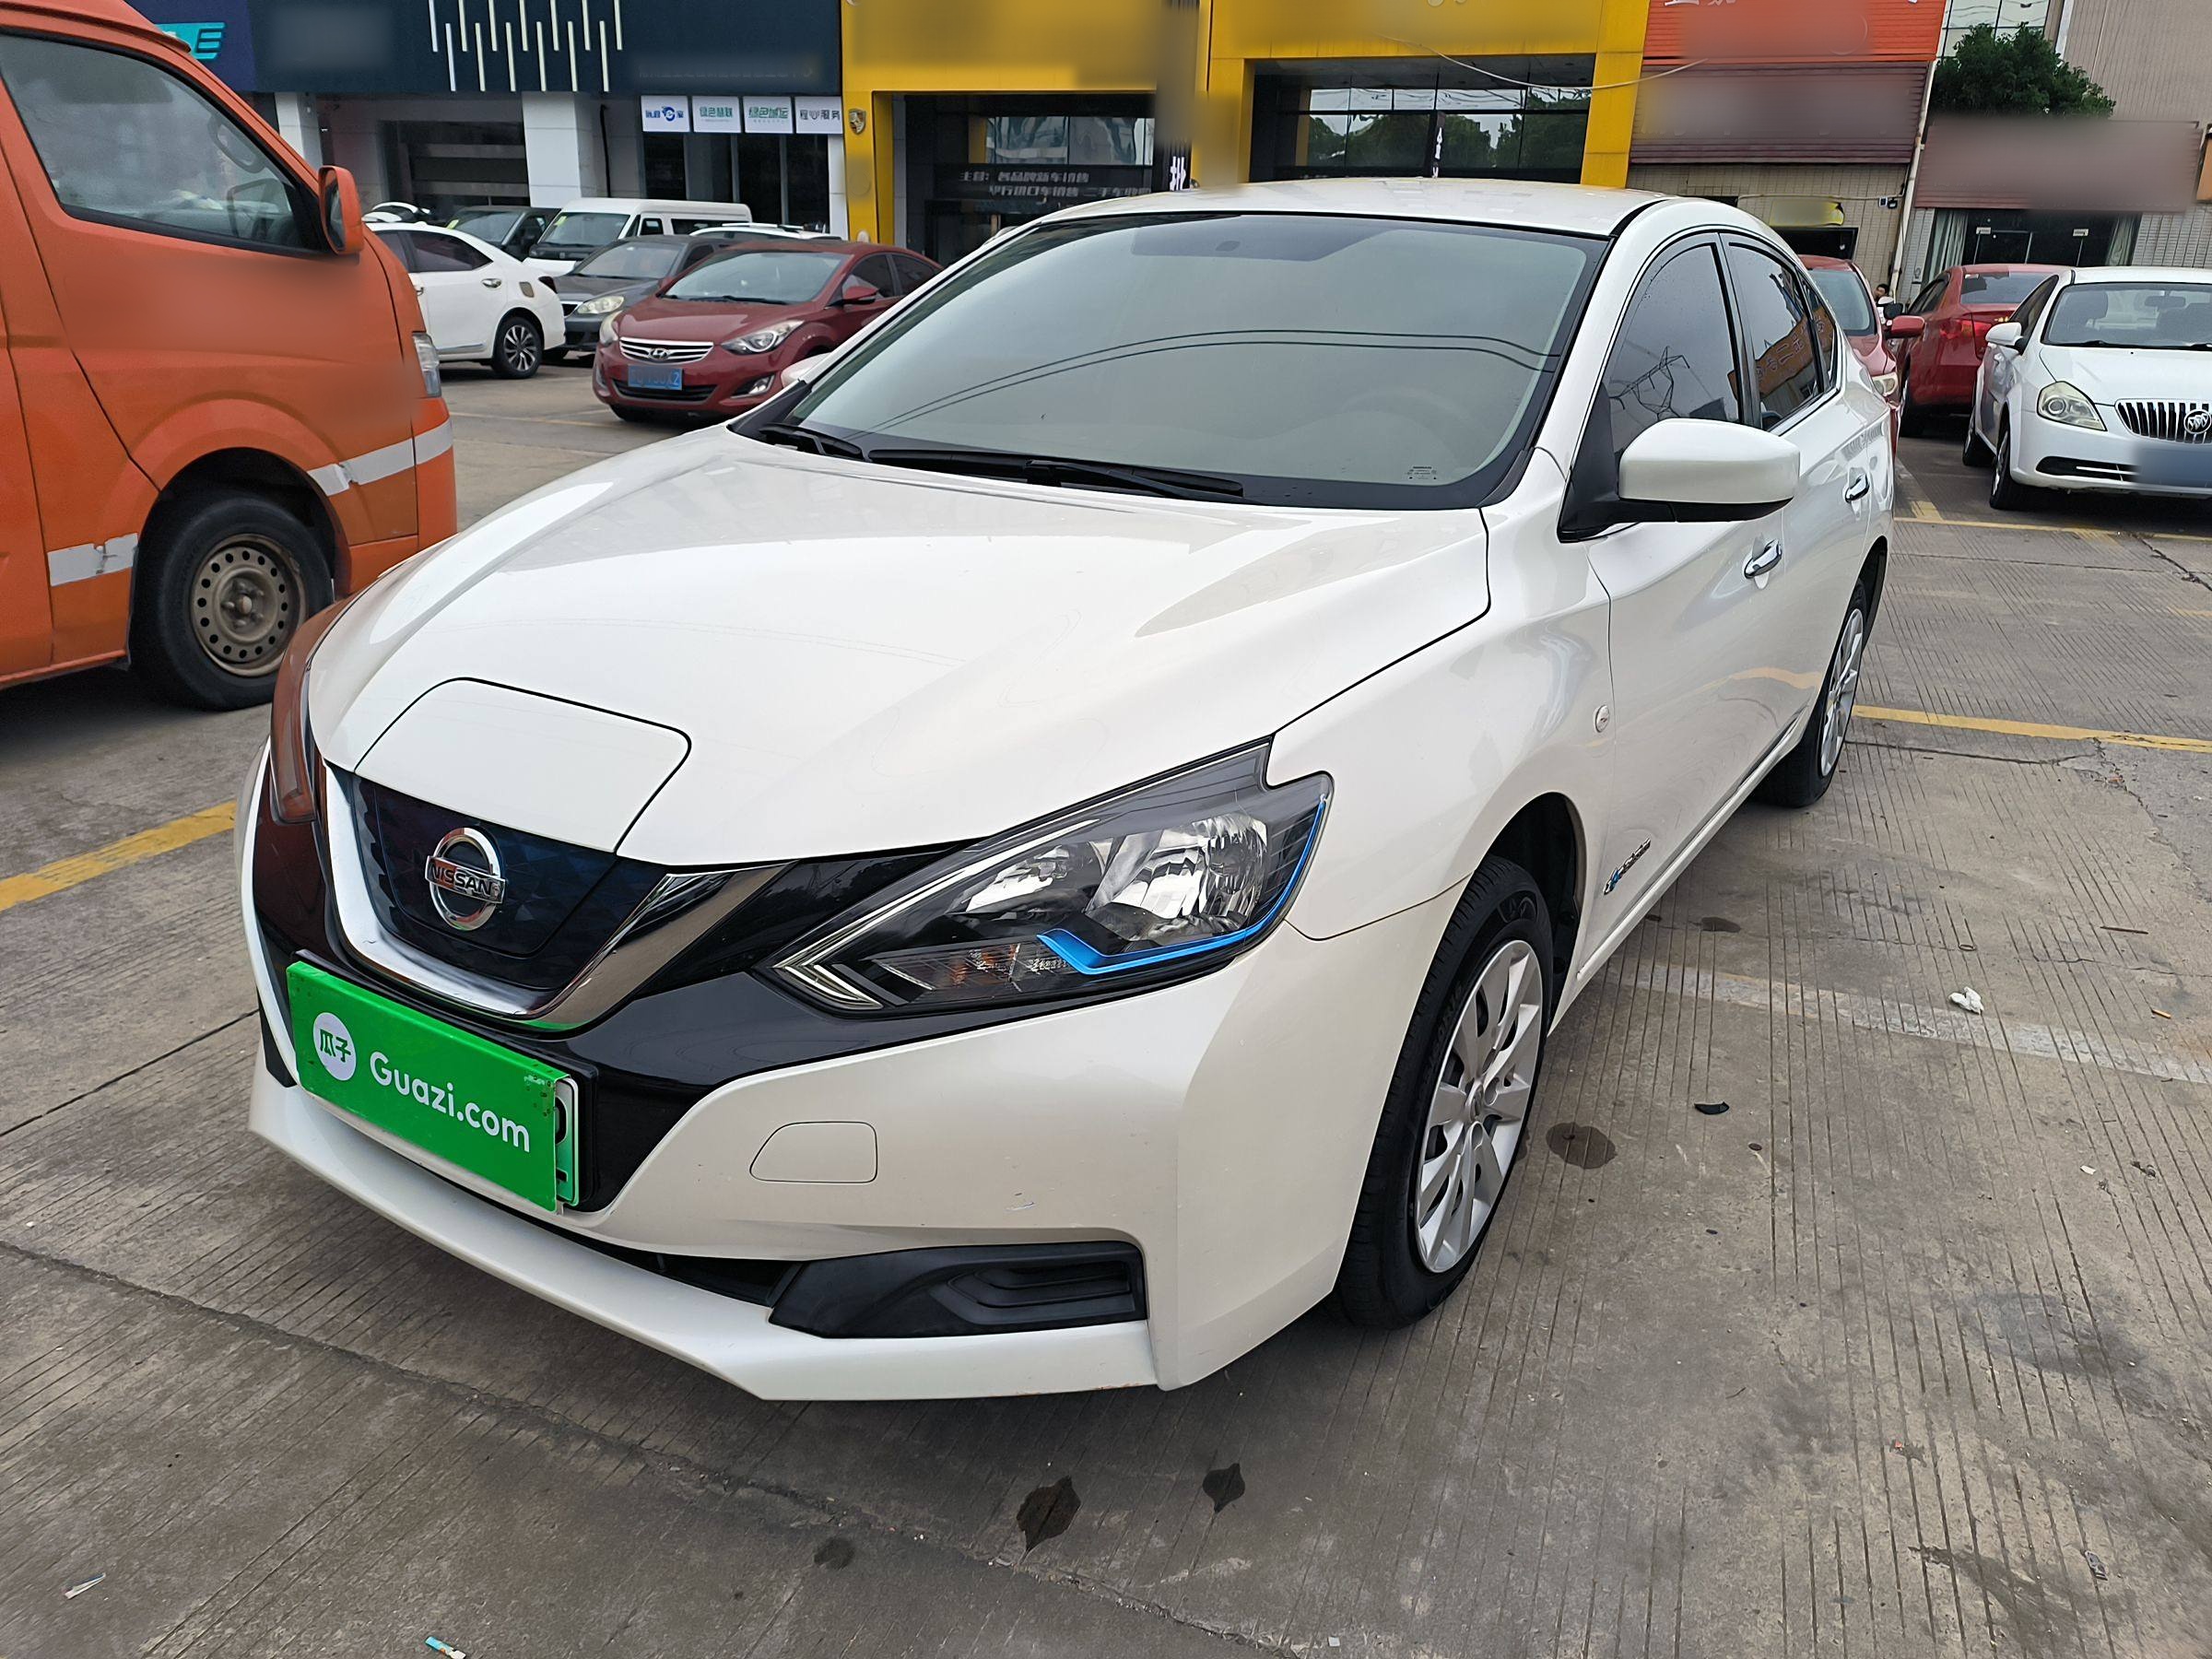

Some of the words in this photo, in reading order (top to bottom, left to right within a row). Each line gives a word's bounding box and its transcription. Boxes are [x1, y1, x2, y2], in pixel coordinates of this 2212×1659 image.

[429, 864, 493, 896] NISSAN
[319, 1029, 352, 1064] 瓜子
[370, 1051, 531, 1153] Guazi.com
